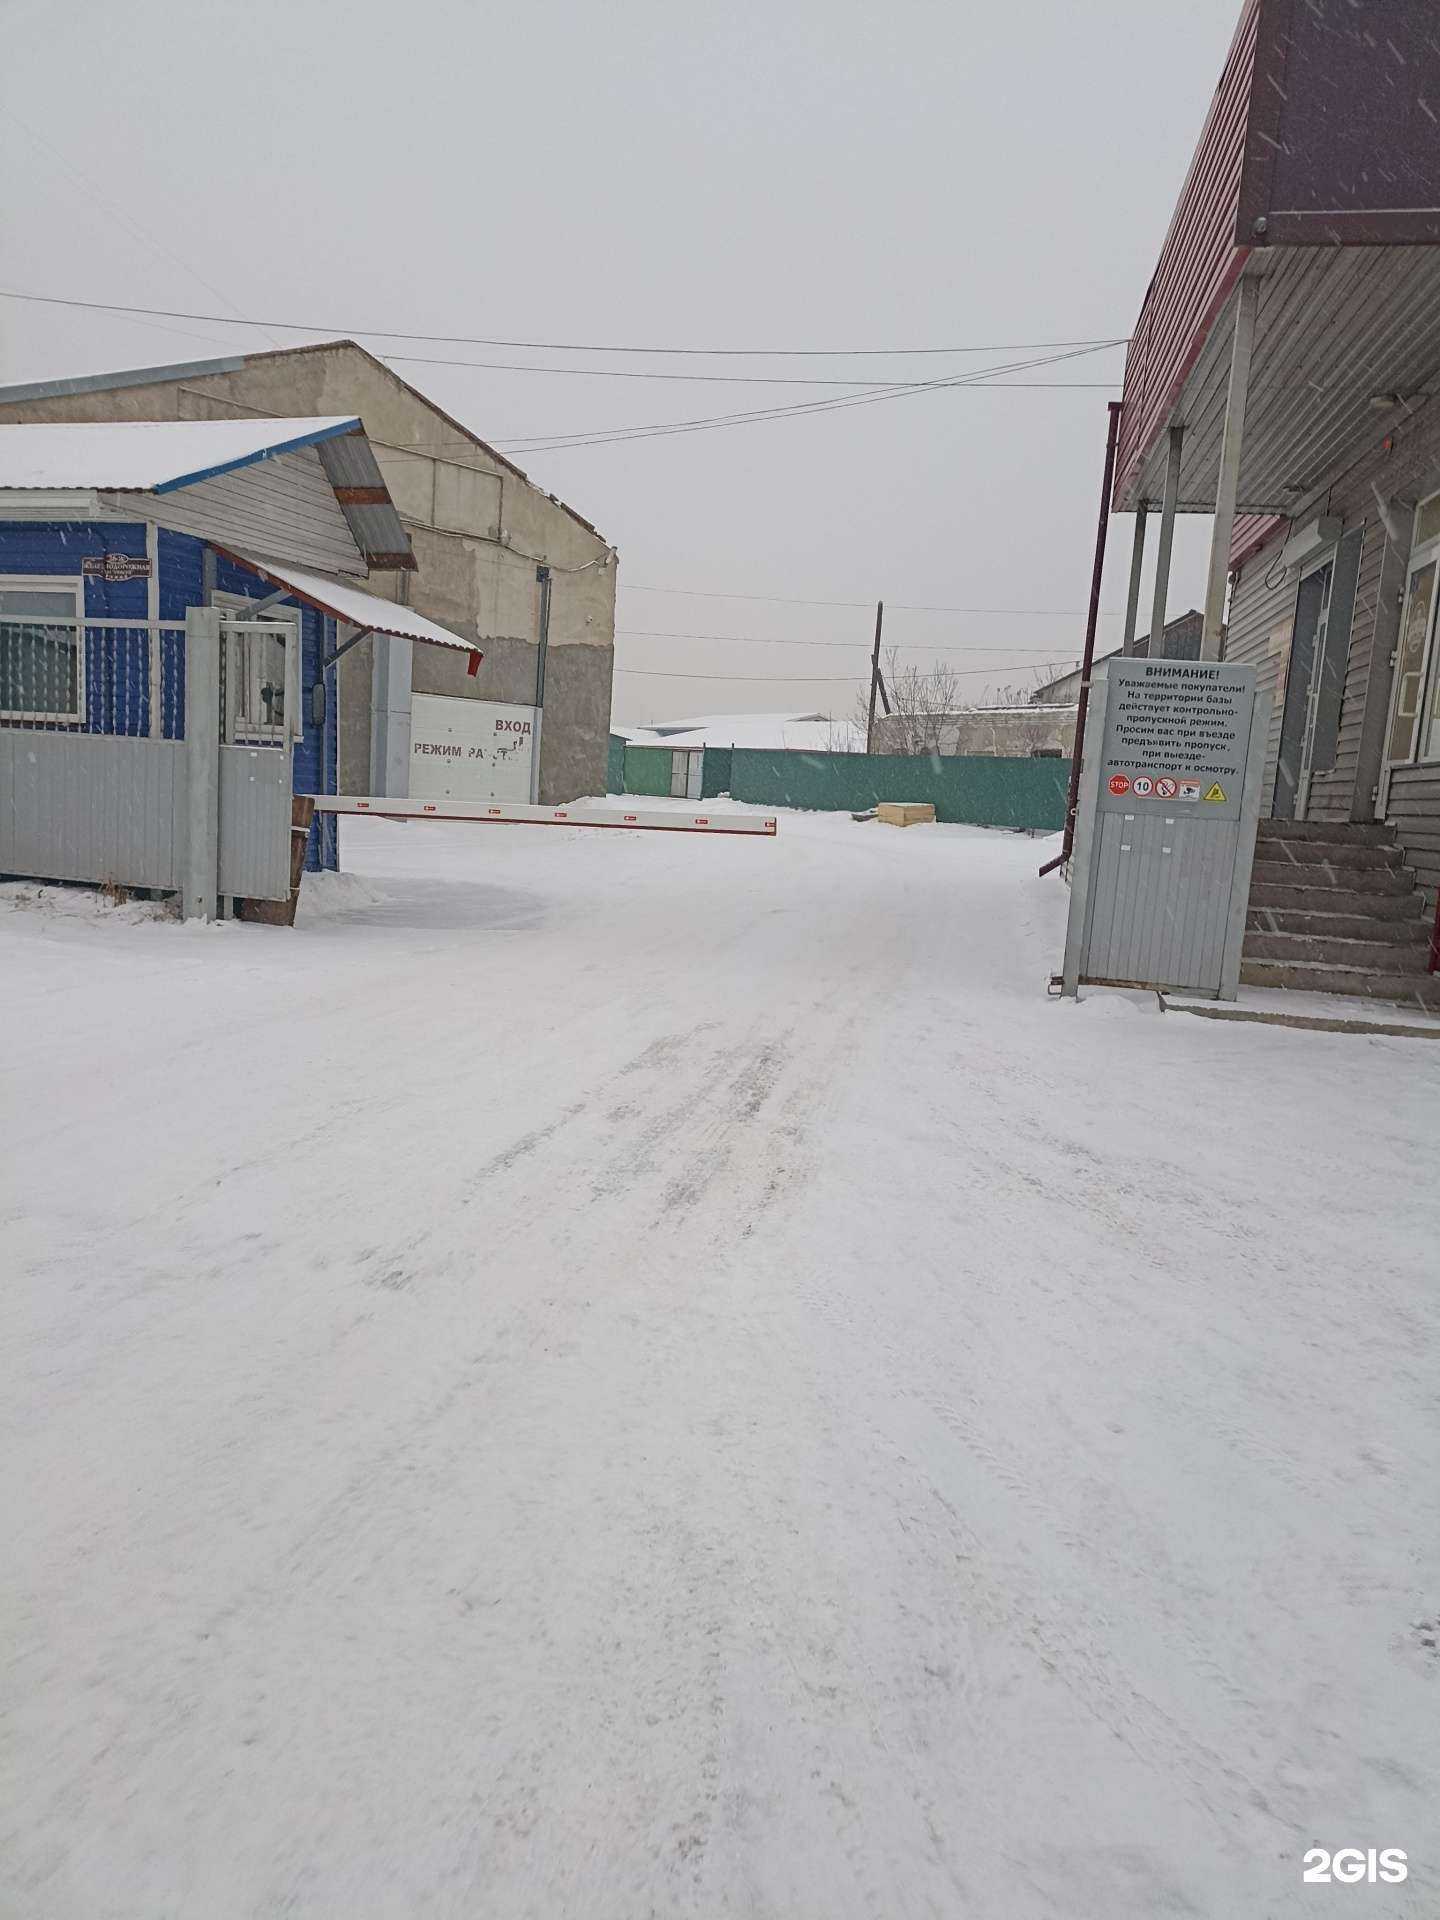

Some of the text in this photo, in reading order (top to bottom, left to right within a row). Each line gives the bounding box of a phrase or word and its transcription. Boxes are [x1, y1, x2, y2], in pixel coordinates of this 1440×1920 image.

[1145, 666, 1220, 680] ВНИМАНИЕ!
[1118, 679, 1246, 694] Уважаемые покупатели!
[1127, 690, 1233, 705] На территории базы
[1118, 702, 1238, 716] действует контрольно-
[495, 719, 531, 736] ВХОД
[1126, 714, 1228, 728] пропускной режим.
[1116, 724, 1236, 741] Просим вас при въезде
[1121, 736, 1182, 748] предъявить
[414, 742, 462, 757] РЕЖИМ
[1142, 748, 1206, 761] при выезде-
[1107, 759, 1183, 772] автотранспорт
[1193, 764, 1240, 776] осмотру.
[1110, 782, 1129, 790] STOP
[1137, 781, 1149, 792] 10
